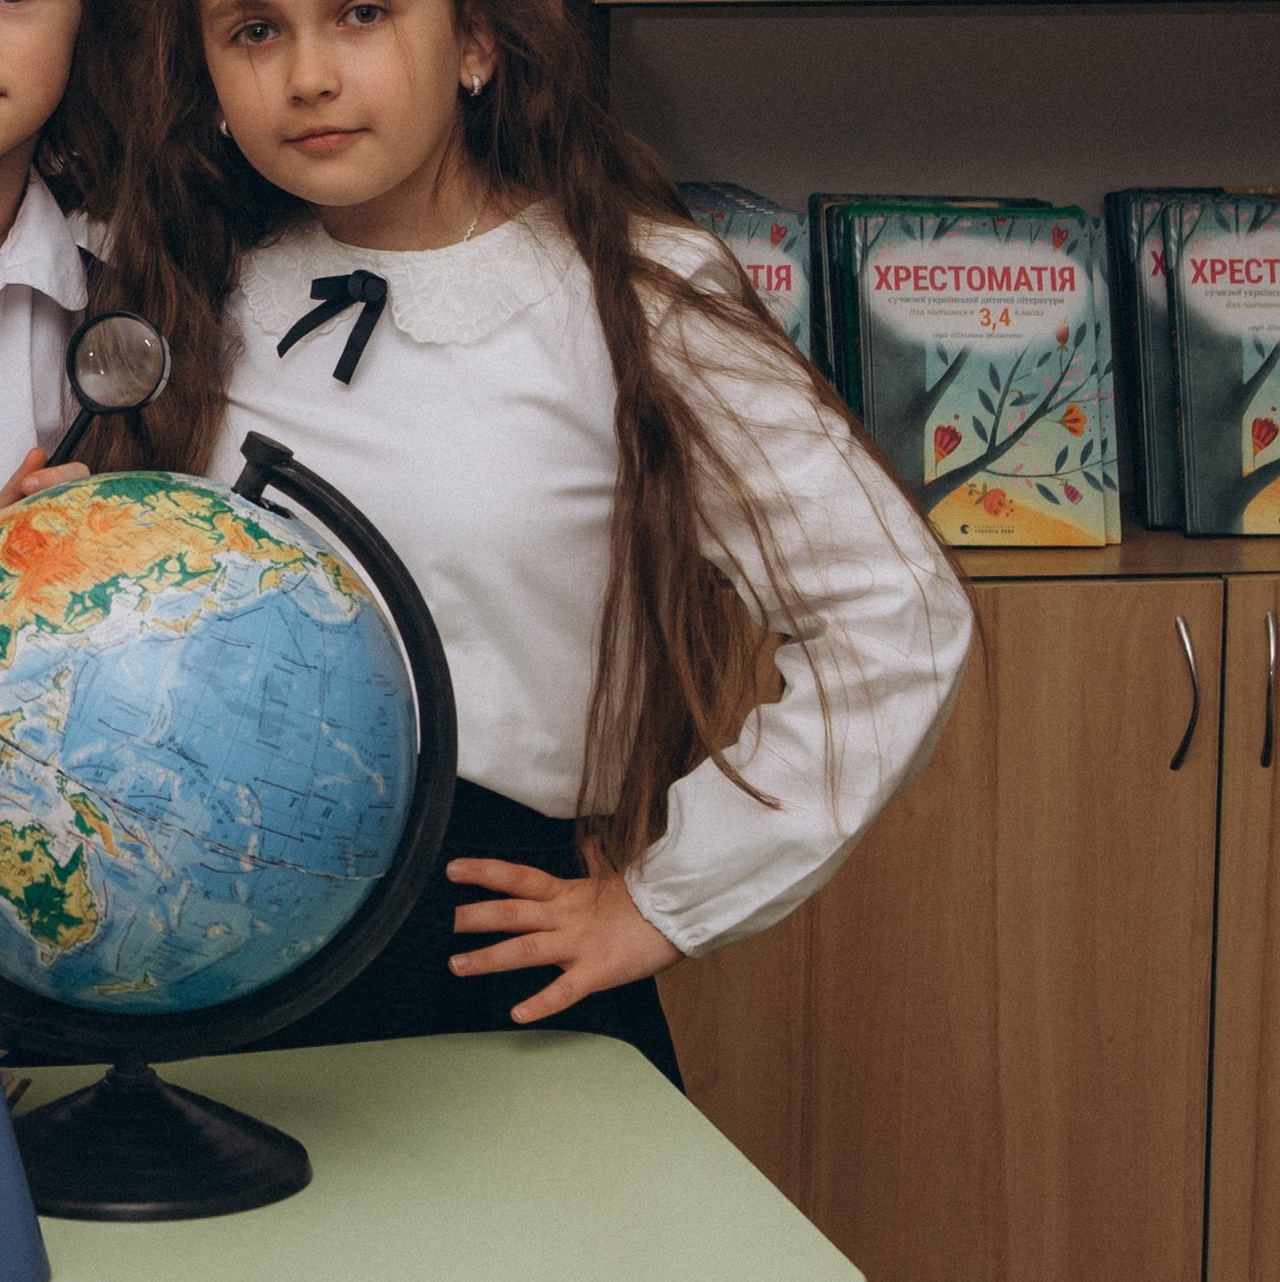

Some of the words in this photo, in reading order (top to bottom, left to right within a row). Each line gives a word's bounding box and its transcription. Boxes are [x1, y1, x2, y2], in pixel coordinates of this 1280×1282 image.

[874, 265, 1076, 293] ХРЕСТОМАТІЯ
[888, 296, 926, 305] сучасної
[927, 296, 979, 305] української
